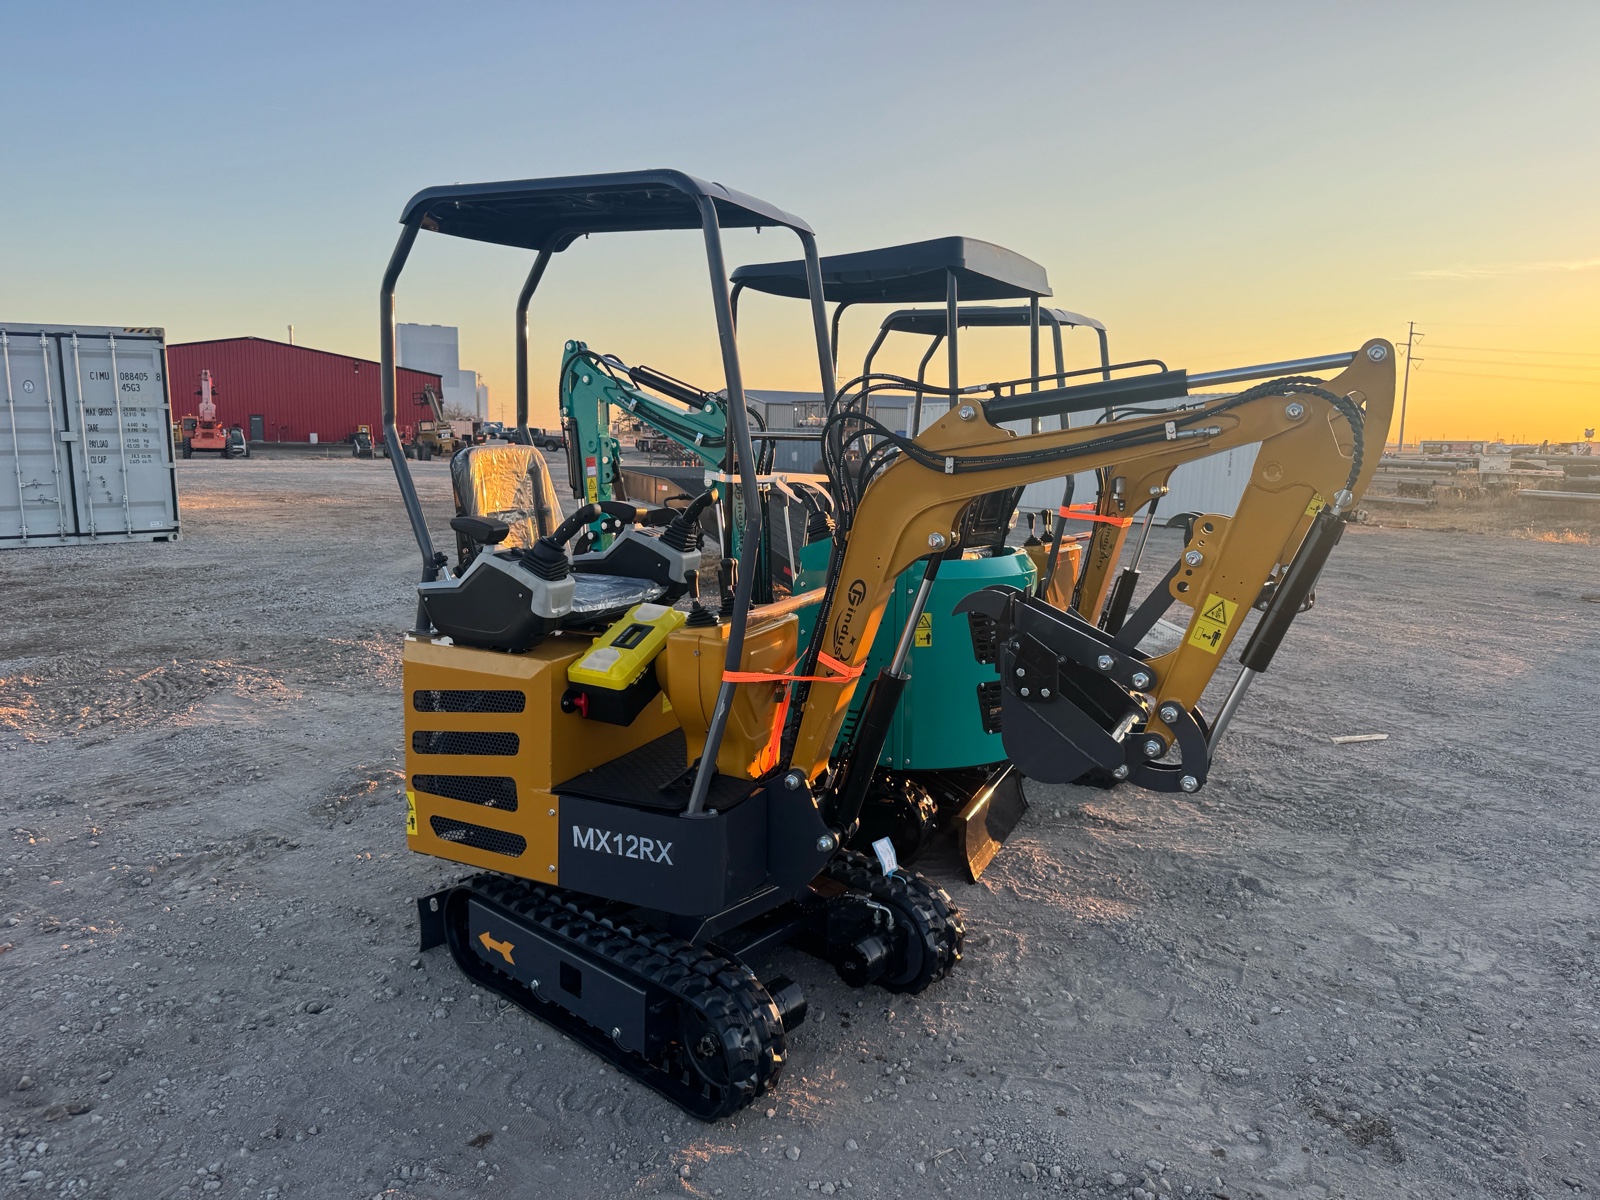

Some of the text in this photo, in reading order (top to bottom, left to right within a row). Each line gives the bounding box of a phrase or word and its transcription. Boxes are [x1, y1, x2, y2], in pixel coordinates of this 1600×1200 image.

[89, 371, 161, 381] CIMU 088405 8
[122, 383, 140, 392] 45G3
[86, 408, 113, 416] MAX GROSS
[87, 424, 99, 432] TARE
[89, 440, 108, 448] PAYLOAD
[572, 825, 673, 866] MX12RX
